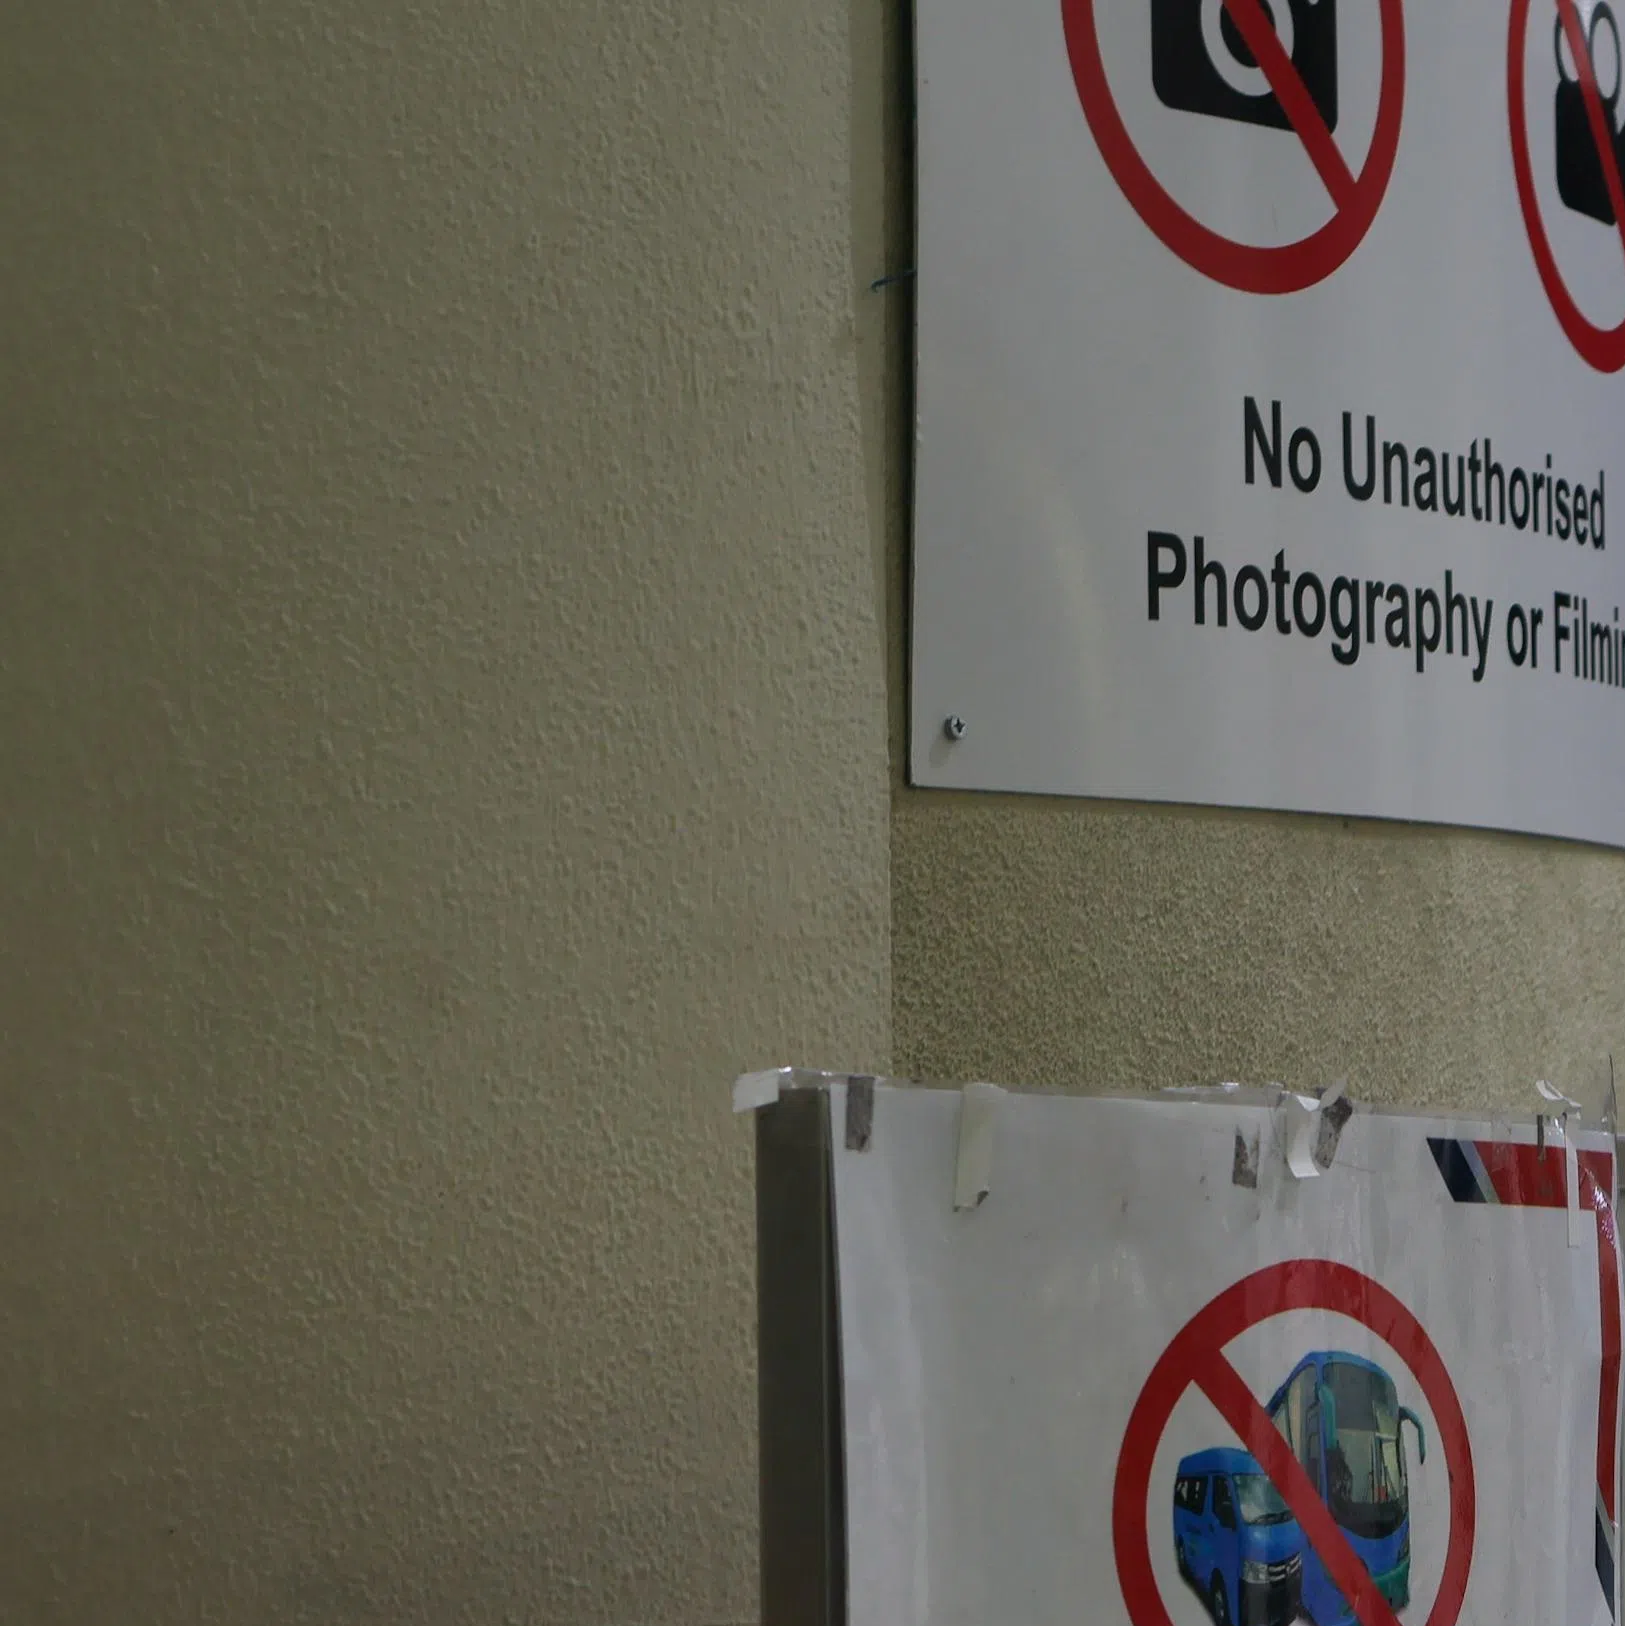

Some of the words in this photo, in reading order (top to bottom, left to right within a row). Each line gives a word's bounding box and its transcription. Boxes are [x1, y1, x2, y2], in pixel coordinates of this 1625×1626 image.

[1243, 395, 1322, 494] No
[1341, 410, 1606, 551] Unauthorised
[1146, 530, 1494, 683] Photography
[1506, 602, 1544, 670] or
